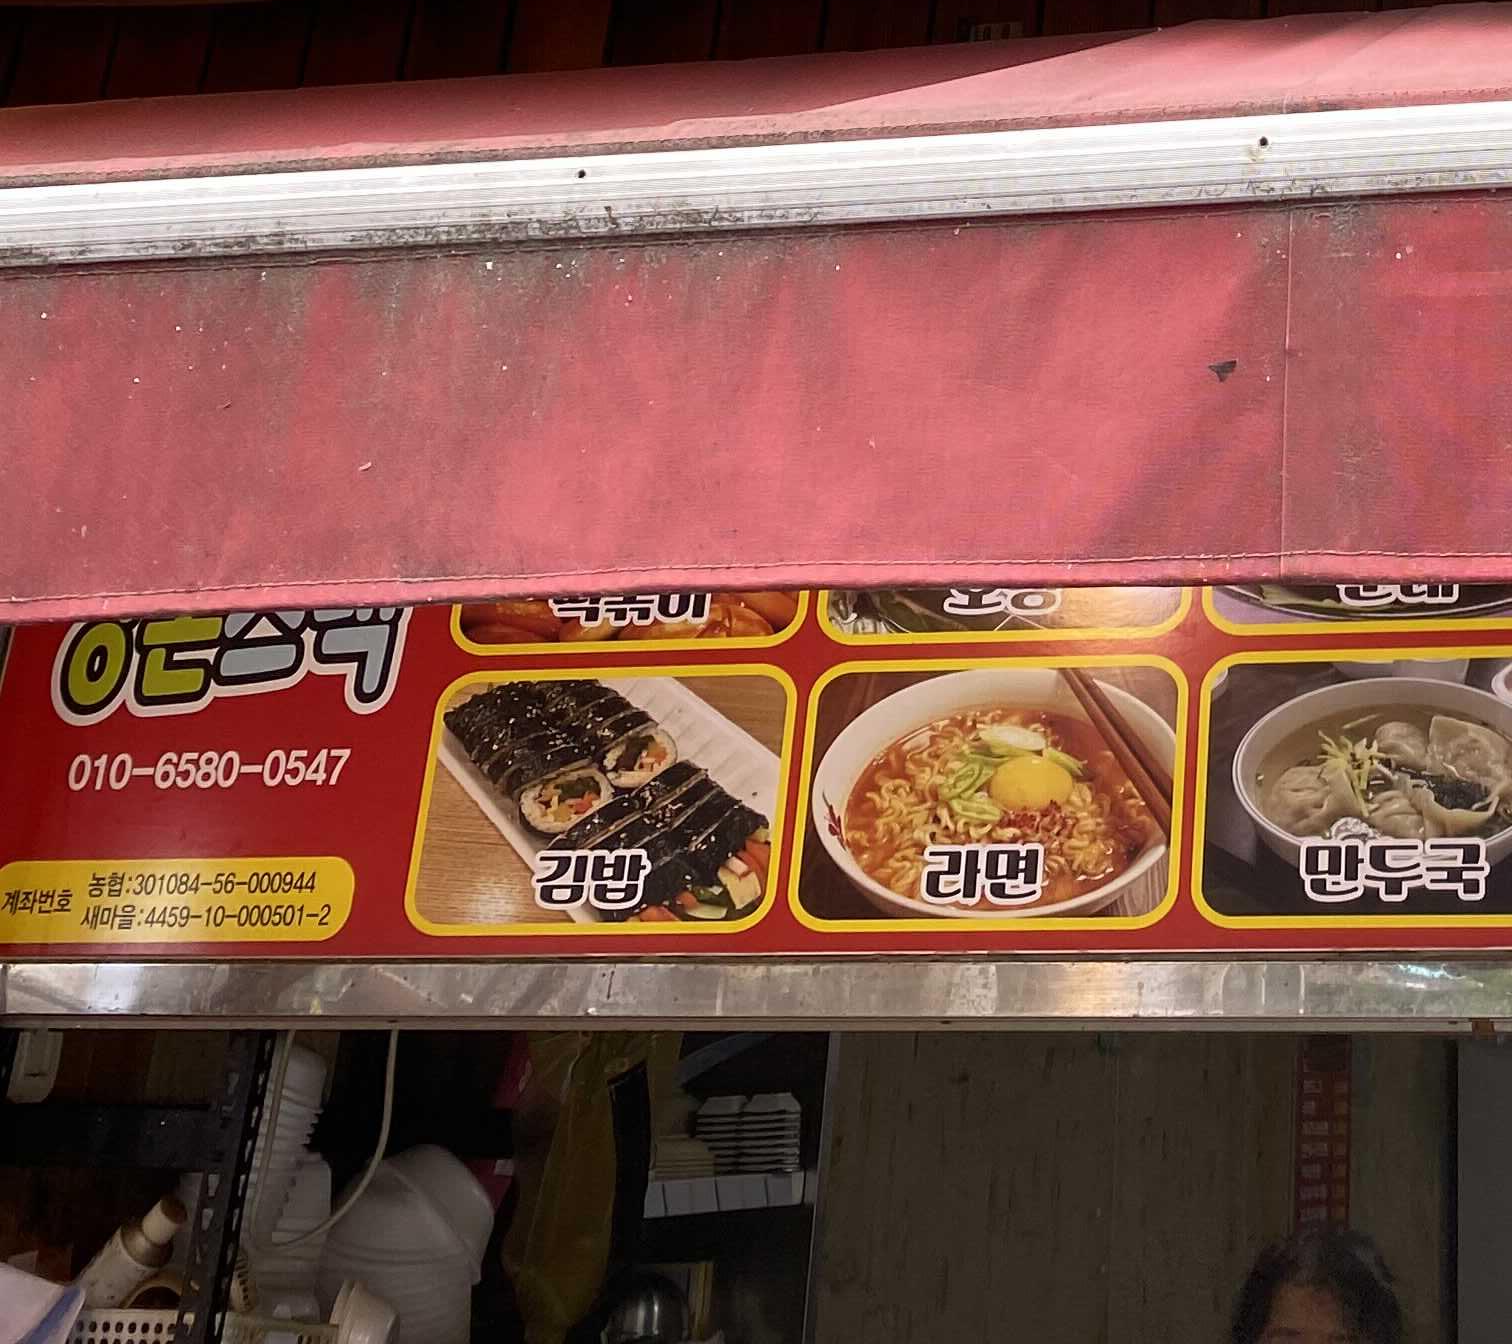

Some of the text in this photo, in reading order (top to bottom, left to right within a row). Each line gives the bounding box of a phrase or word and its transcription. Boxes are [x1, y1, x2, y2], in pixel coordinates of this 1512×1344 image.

[67, 748, 352, 792] 010-6580-0547
[86, 871, 317, 900] 농협:301084-56-000944
[532, 849, 651, 910] 김밥
[920, 843, 1046, 905] 라면
[1299, 836, 1491, 901] 만두국
[1, 888, 74, 915] 계좌번호
[80, 903, 332, 931] 새마을:4459-10-000501-2
